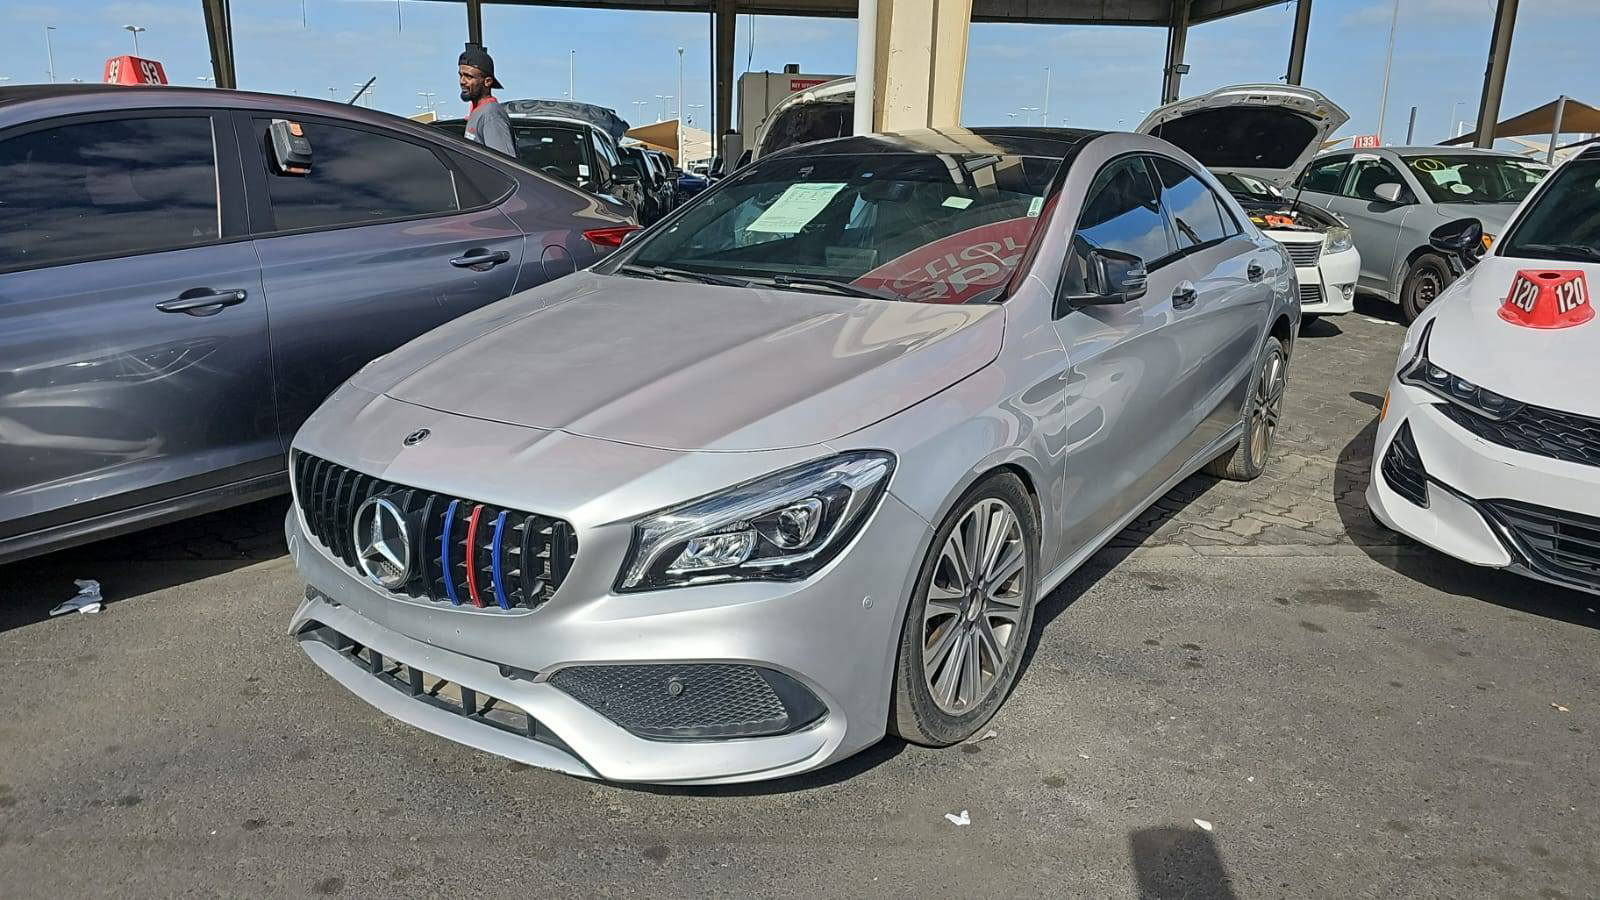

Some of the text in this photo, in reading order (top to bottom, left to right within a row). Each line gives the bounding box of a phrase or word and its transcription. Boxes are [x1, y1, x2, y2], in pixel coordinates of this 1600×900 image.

[109, 60, 120, 84] 93
[140, 60, 161, 86] 93
[1359, 136, 1374, 147] 133
[1511, 277, 1539, 313] 120
[1556, 277, 1584, 313] 120
